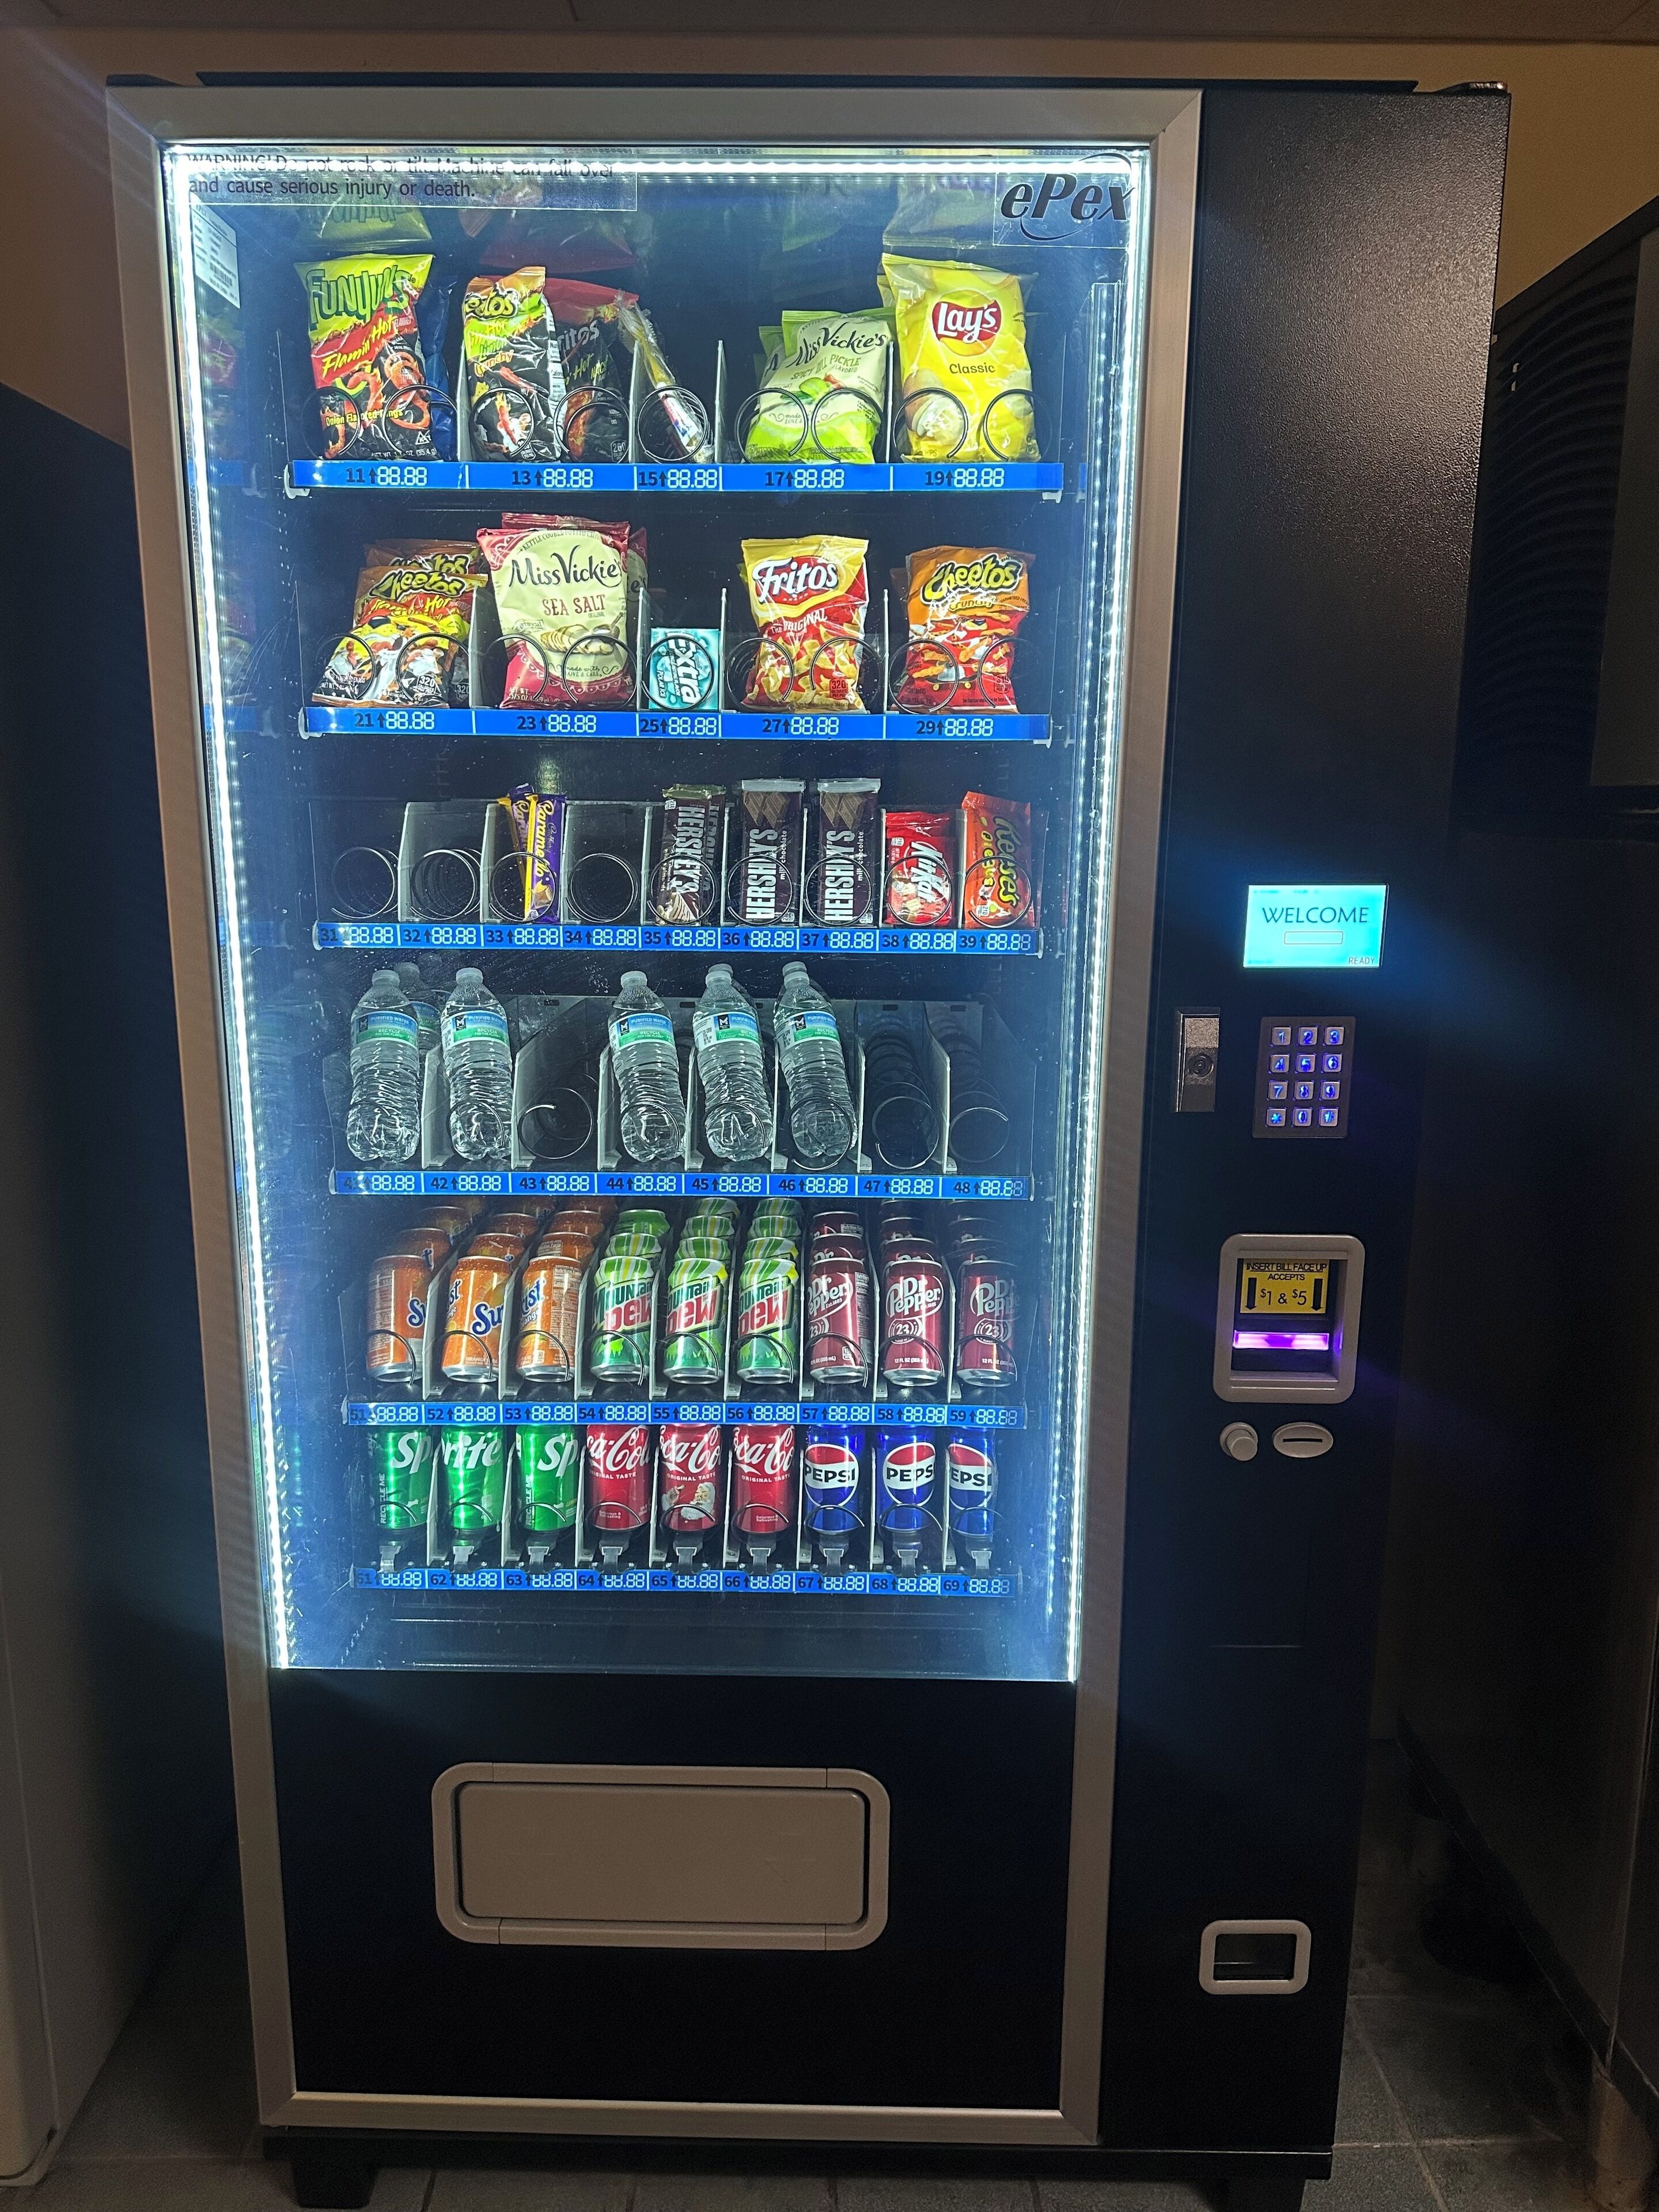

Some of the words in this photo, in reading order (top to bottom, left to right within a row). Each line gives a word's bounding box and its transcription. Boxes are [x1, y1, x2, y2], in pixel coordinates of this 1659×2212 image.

[190, 177, 218, 193] and
[227, 181, 272, 194] cause
[280, 178, 338, 195] serious
[346, 179, 392, 199] injury
[400, 183, 416, 196] or
[425, 181, 475, 198] death.
[1001, 173, 1136, 221] ePex
[370, 315, 398, 342] Hot
[937, 302, 998, 343] Lay's
[785, 337, 821, 369] Miss
[820, 322, 887, 355] Vickie's
[830, 354, 862, 367] PICKLE
[950, 363, 995, 374] Classic
[346, 468, 365, 483] 11
[512, 470, 531, 485] 13
[638, 472, 658, 486] 15
[765, 472, 784, 486] 17
[925, 471, 946, 486] 19
[509, 558, 560, 588] Miss
[752, 556, 839, 603] Fritos
[924, 556, 1018, 601] Cheetos
[425, 596, 450, 612] Hot
[543, 598, 569, 616] SEA
[573, 594, 605, 613] SALT
[783, 608, 828, 631] ORIGINAL
[831, 680, 846, 690] 320
[354, 713, 372, 726] 21
[517, 717, 536, 730] 23
[640, 719, 658, 733] 25
[762, 719, 782, 732] 27
[916, 721, 935, 734] 29
[673, 806, 705, 893] HERSHEY'S
[1262, 907, 1369, 923] WELCOME
[404, 929, 420, 942] 32
[486, 930, 503, 942] 33
[565, 930, 582, 943] 34
[643, 931, 661, 944] 35
[722, 932, 740, 945] 36
[802, 933, 819, 946] 37
[882, 935, 899, 948] 38
[960, 936, 977, 949] 39
[1348, 956, 1375, 964] READY
[1278, 1031, 1285, 1043] 1
[1303, 1031, 1312, 1043] 2
[1330, 1030, 1339, 1043] 3
[1275, 1058, 1284, 1070] 4
[1301, 1058, 1311, 1070] 5
[1327, 1056, 1338, 1069] 6
[1274, 1085, 1283, 1098] 7
[1325, 1085, 1335, 1098] 9
[430, 1177, 448, 1189] 42
[520, 1177, 536, 1189] 43
[607, 1179, 624, 1190] 44
[692, 1179, 709, 1190] 45
[779, 1179, 796, 1190] 46
[864, 1180, 880, 1192] 47
[953, 1181, 971, 1194] 48
[1247, 1262, 1275, 1271] INSERT
[1276, 1263, 1292, 1271] BILL
[1293, 1263, 1315, 1271] FACE
[1316, 1263, 1327, 1271] UP
[890, 1283, 940, 1318] Pepper
[1278, 1293, 1287, 1304] &
[427, 1408, 444, 1420] 52
[505, 1408, 521, 1420] 53
[578, 1407, 595, 1419] 54
[653, 1407, 671, 1419] 55
[728, 1407, 744, 1419] 56
[802, 1408, 819, 1420] 57
[877, 1408, 894, 1421] 58
[950, 1409, 967, 1421] 59
[430, 1573, 447, 1585] 62
[506, 1574, 522, 1585] 63
[578, 1575, 594, 1586] 64
[652, 1575, 668, 1586] 65
[724, 1575, 741, 1587] 66
[798, 1577, 814, 1588] 67
[872, 1577, 888, 1589] 68
[944, 1580, 960, 1590] 69
